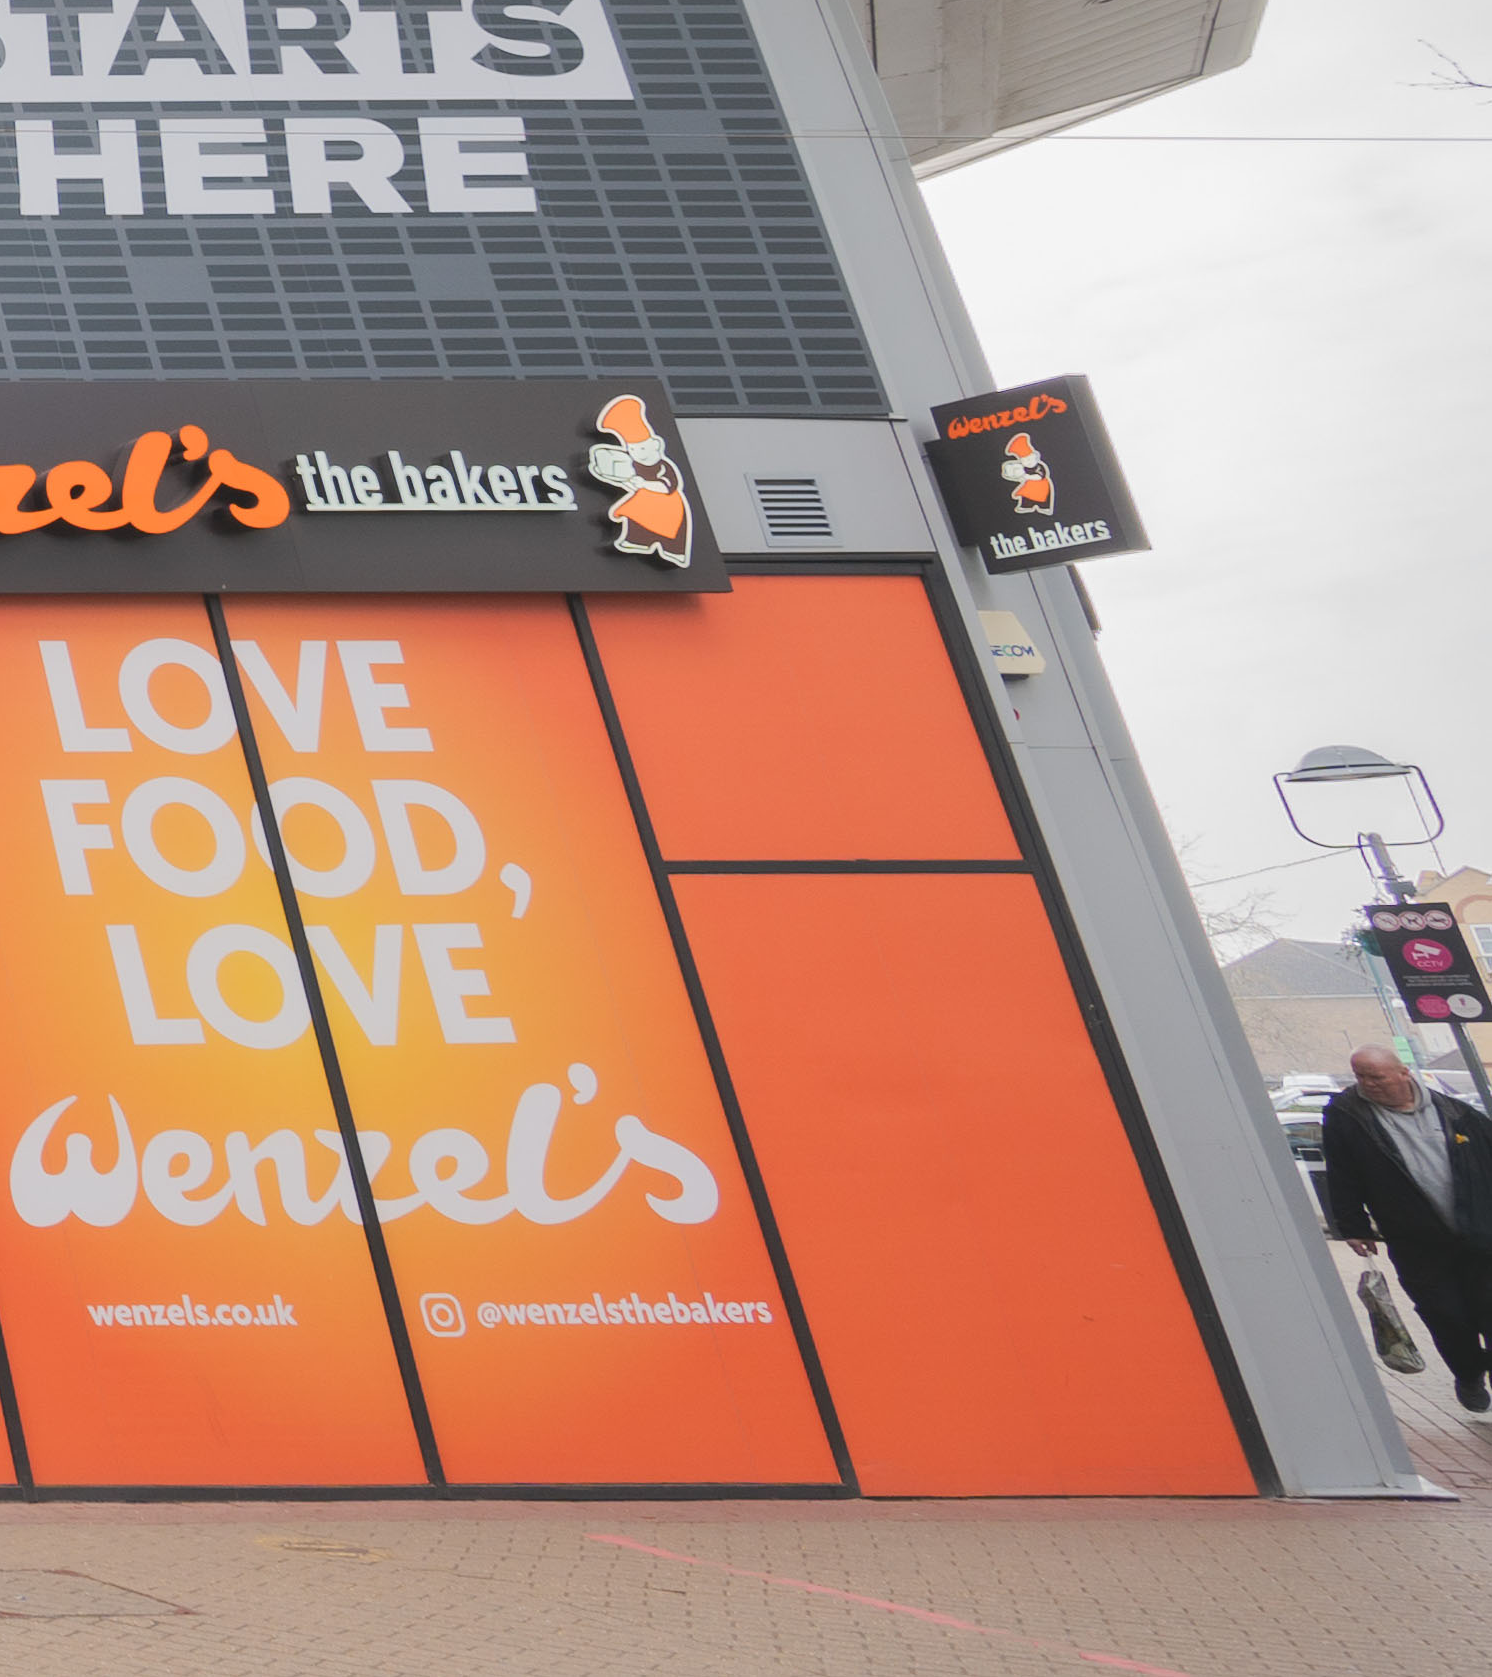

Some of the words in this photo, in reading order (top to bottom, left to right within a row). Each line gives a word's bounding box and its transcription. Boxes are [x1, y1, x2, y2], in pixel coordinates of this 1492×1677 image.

[14, 116, 537, 216] HERE
[296, 451, 382, 506] the
[387, 450, 575, 506] bakers
[990, 532, 1027, 557] the
[1028, 519, 1110, 549] bakers
[38, 638, 434, 755] LOVE
[40, 776, 532, 920] FOOD,
[106, 923, 517, 1050] LOVE
[87, 1294, 298, 1327] wenzels.co.uk
[477, 1294, 772, 1328] @wenzelsthebakers
